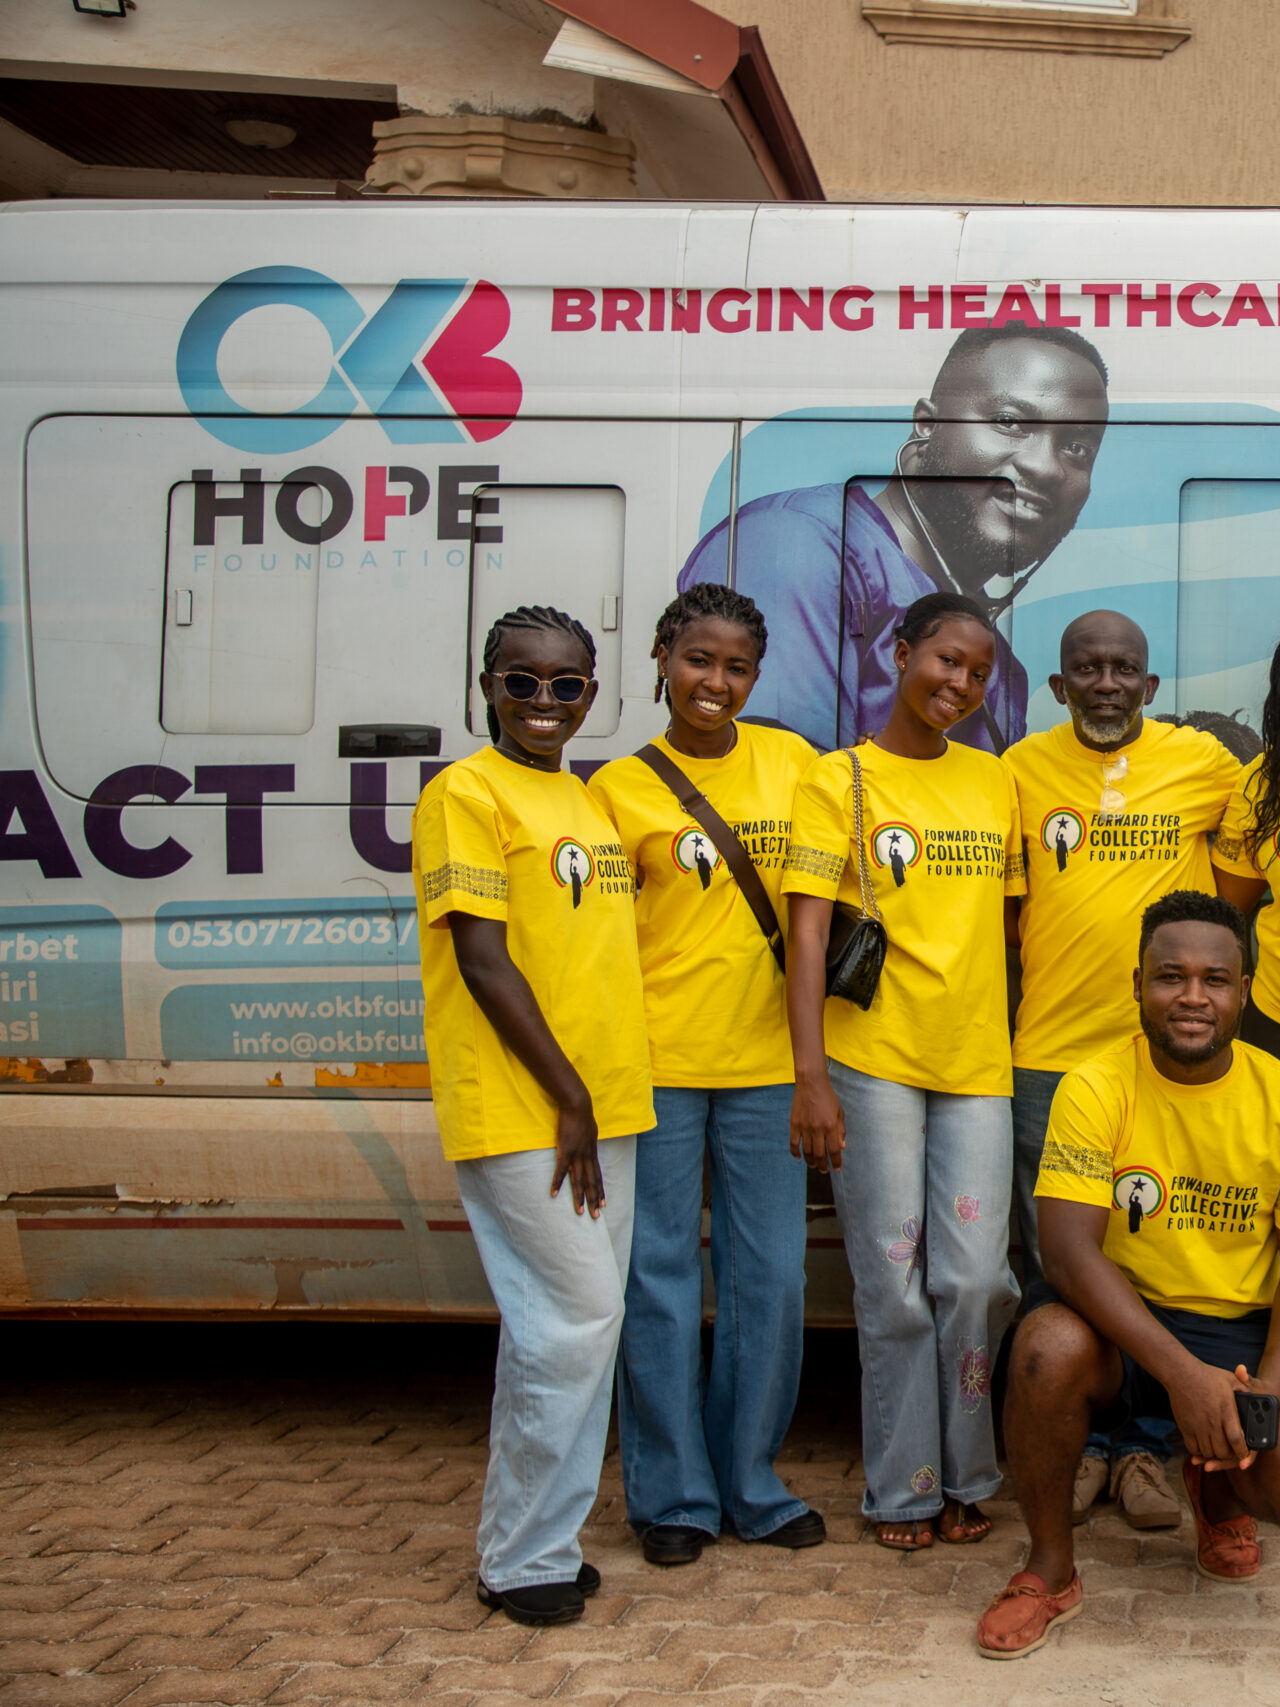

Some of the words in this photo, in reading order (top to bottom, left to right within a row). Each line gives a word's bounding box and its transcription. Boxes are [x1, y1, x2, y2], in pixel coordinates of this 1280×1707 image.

[551, 285, 874, 334] BRINGING
[192, 465, 503, 546] HOPE
[193, 549, 503, 573] FOUNDATION
[1091, 814, 1149, 827] FORWARD
[1152, 814, 1180, 828] EVER
[925, 829, 977, 842] FORWARD
[980, 831, 1002, 846] EVER
[1090, 829, 1180, 847] COLLECTIVE
[926, 844, 1004, 866] COLLECTIVE
[1089, 848, 1179, 861] FOUNDATION
[1171, 1176, 1222, 1197] FRWARD
[1224, 1186, 1258, 1201] EVER
